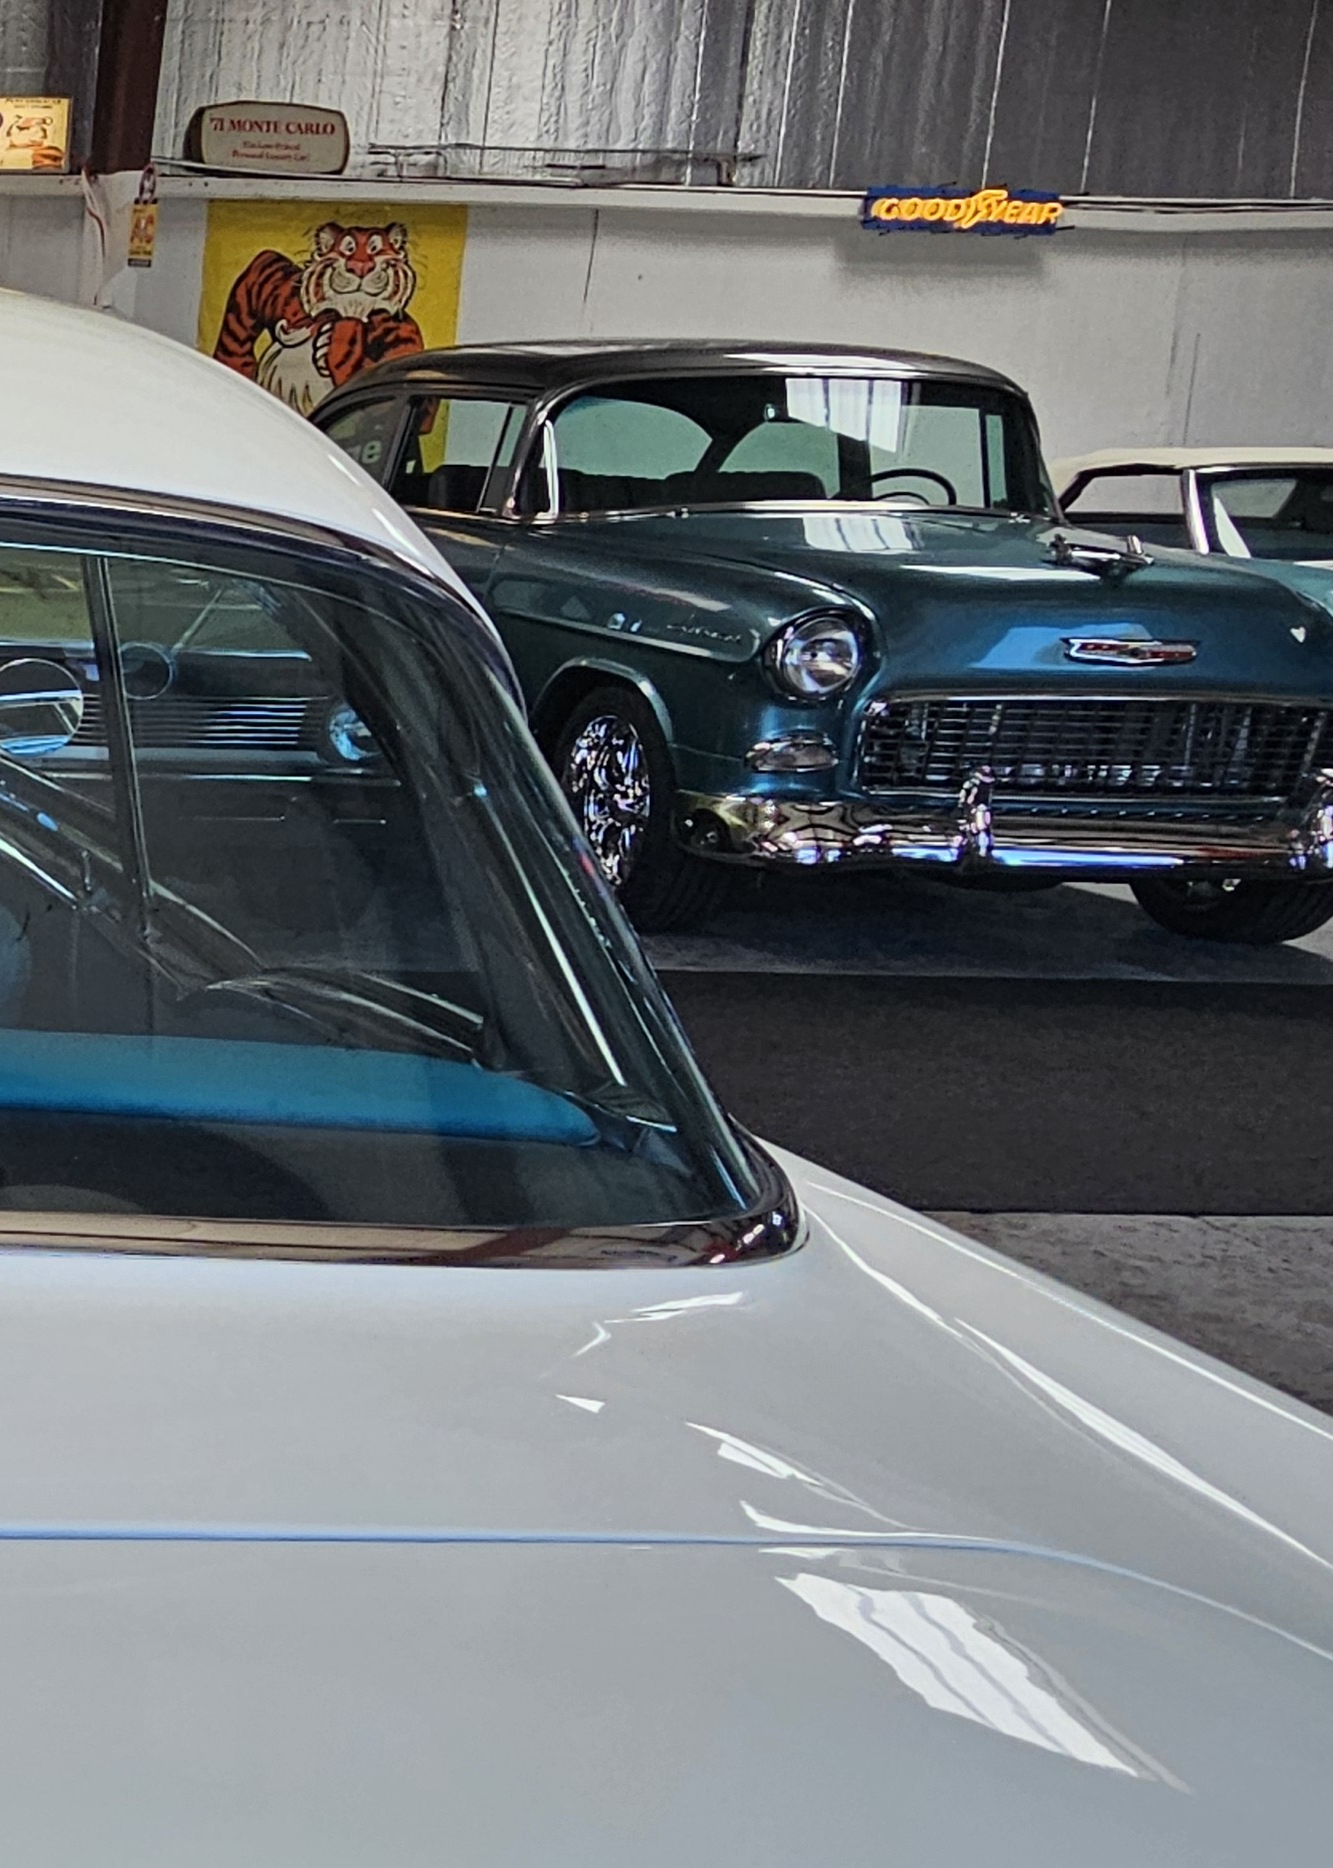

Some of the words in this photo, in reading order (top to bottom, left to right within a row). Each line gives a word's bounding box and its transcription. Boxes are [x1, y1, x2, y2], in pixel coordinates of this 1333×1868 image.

[227, 119, 280, 133] MONTE
[285, 122, 336, 136] CARLO
[871, 194, 1064, 226] GOODYEAR
